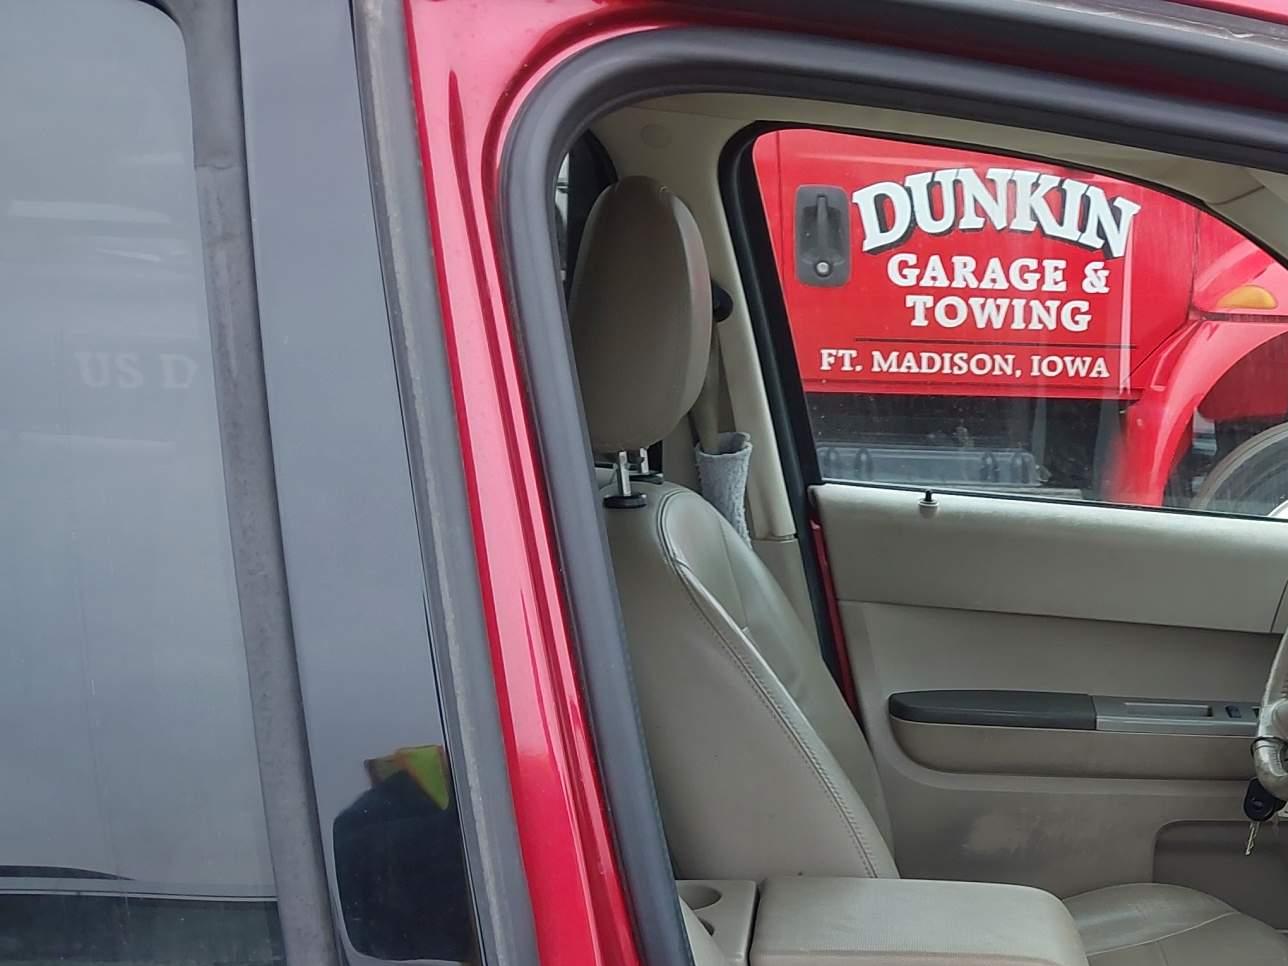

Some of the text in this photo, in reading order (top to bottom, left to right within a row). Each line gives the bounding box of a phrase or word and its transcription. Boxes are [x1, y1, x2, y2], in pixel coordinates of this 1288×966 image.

[852, 167, 1141, 258] DUNKIN
[886, 253, 1110, 294] GARAGE &
[905, 295, 1093, 331] TOWING
[819, 349, 1110, 378] FT. MADISON, IOWA
